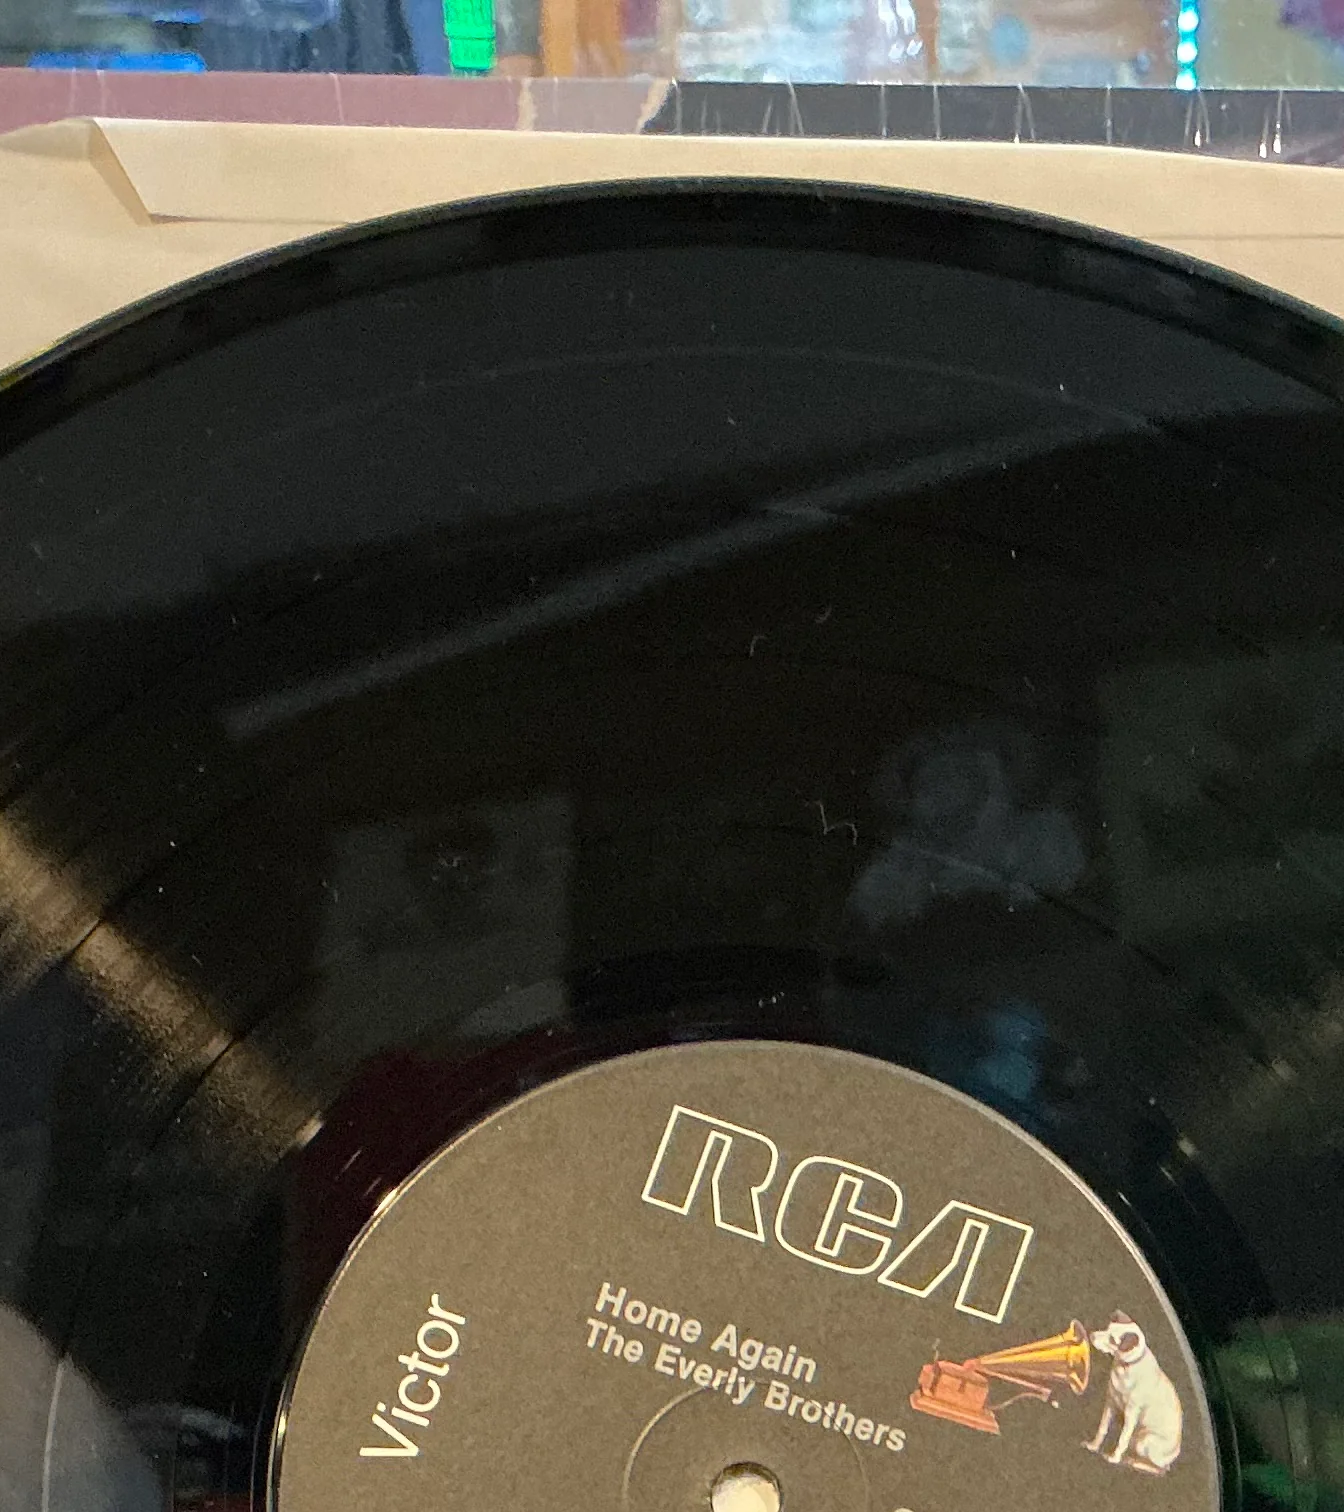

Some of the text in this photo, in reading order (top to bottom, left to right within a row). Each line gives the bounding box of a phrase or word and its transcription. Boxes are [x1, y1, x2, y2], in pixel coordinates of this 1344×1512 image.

[641, 1104, 1035, 1325] RCA
[359, 1293, 466, 1457] Victor
[586, 1317, 906, 1452] The Everly Brothers
[595, 1282, 817, 1383] Home Again
